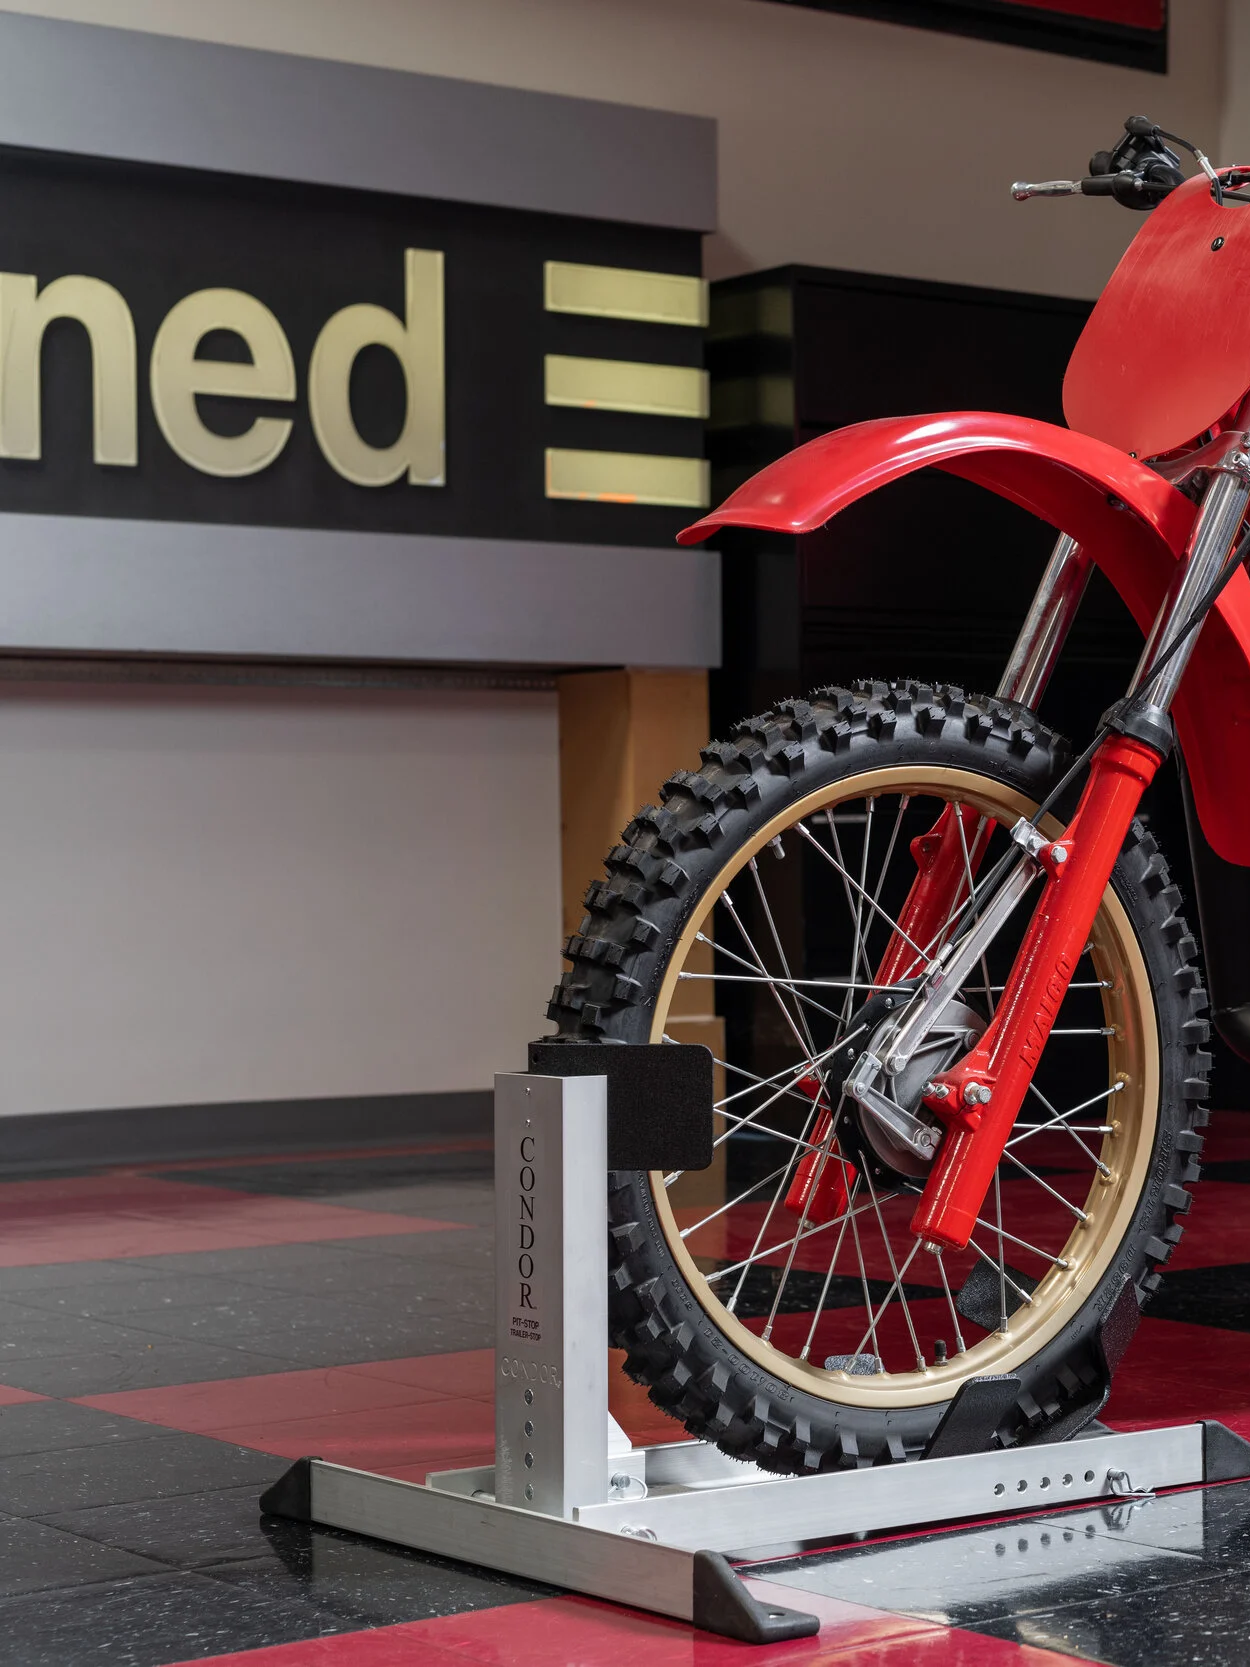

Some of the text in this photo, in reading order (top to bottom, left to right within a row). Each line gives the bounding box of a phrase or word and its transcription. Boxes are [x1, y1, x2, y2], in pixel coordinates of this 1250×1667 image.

[1018, 955, 1072, 1072] MAICO
[518, 1135, 538, 1309] CONDOR
[510, 1328, 542, 1341] TRAILER-STOP
[512, 1316, 540, 1330] PIT-STOP
[501, 1356, 559, 1387] CONDOR
